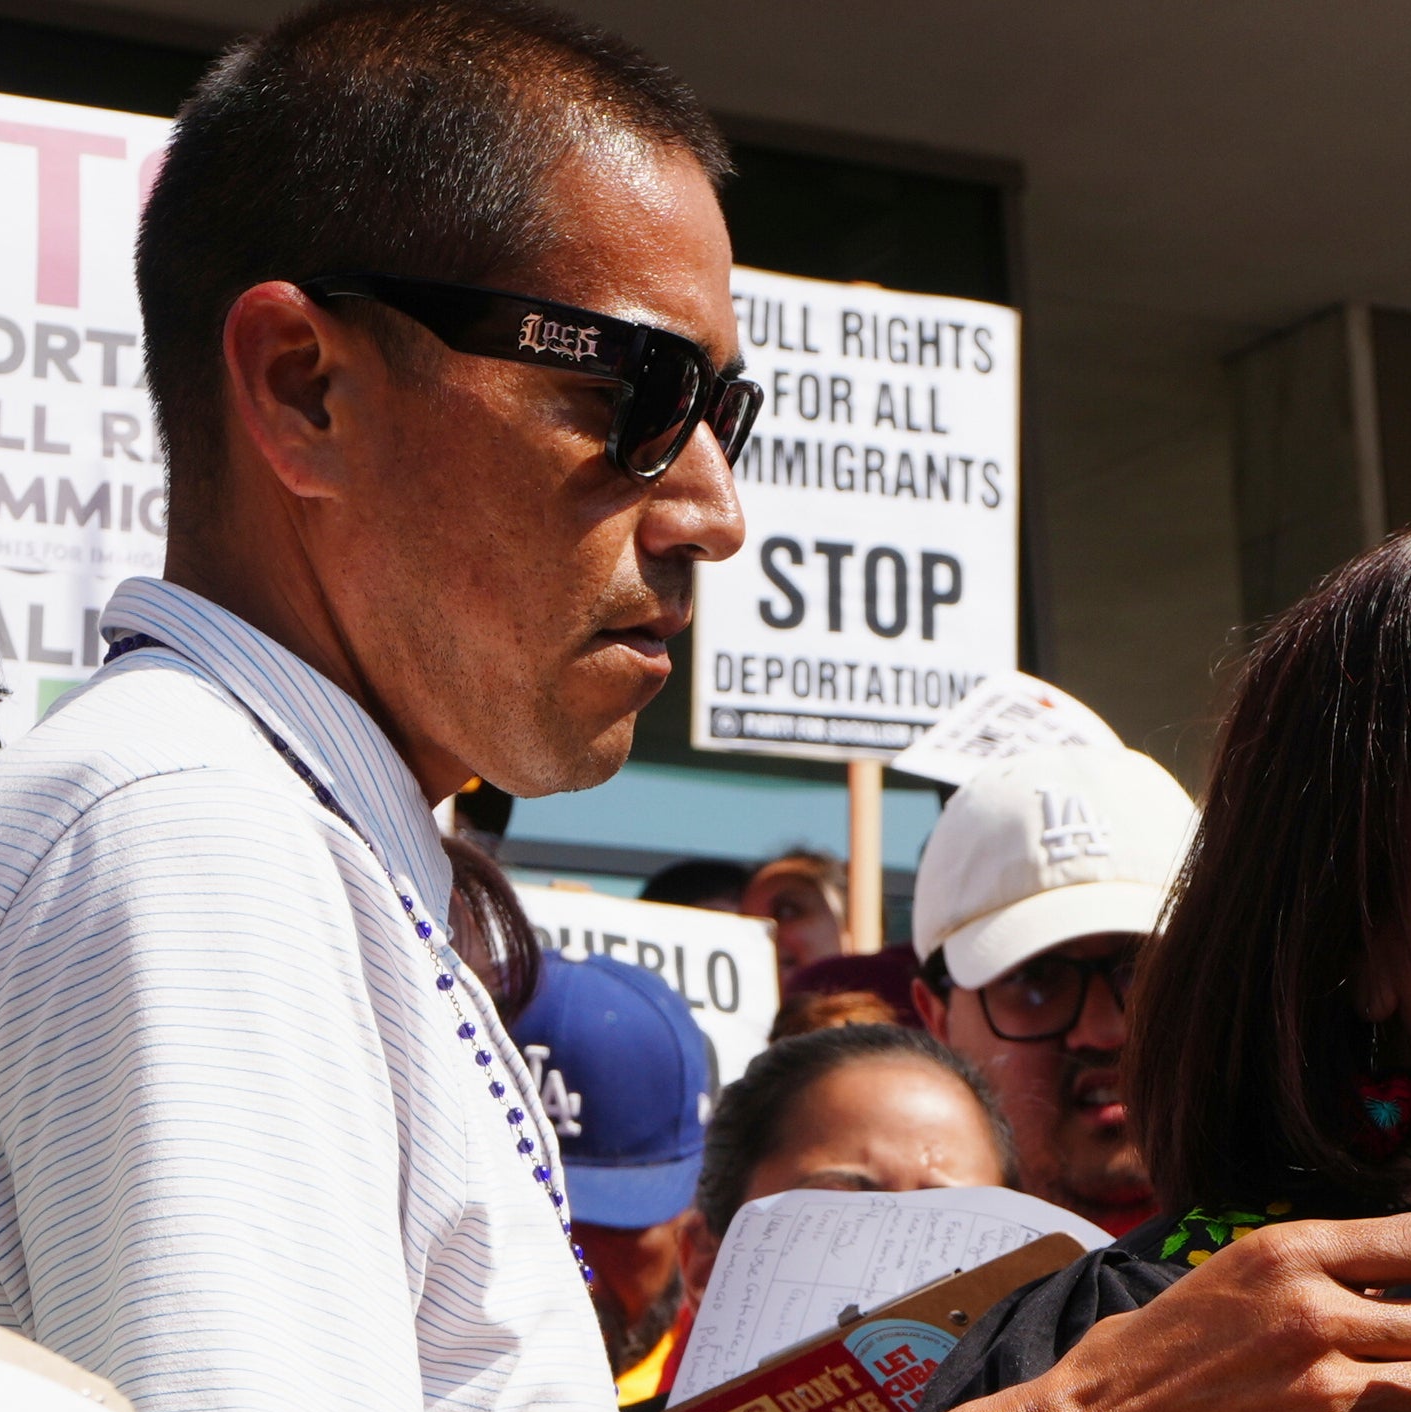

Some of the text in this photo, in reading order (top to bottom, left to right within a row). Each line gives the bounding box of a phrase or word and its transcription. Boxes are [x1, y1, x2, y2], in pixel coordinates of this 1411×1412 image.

[841, 309, 993, 374] RIGHTS
[773, 370, 949, 434] FOR ALL
[736, 434, 1001, 509] MMIGRANTS
[759, 536, 963, 641] STOP
[1035, 788, 1110, 864] LA
[524, 1044, 582, 1137] LA
[872, 1344, 918, 1378] LET
[882, 1357, 940, 1398] CUBA
